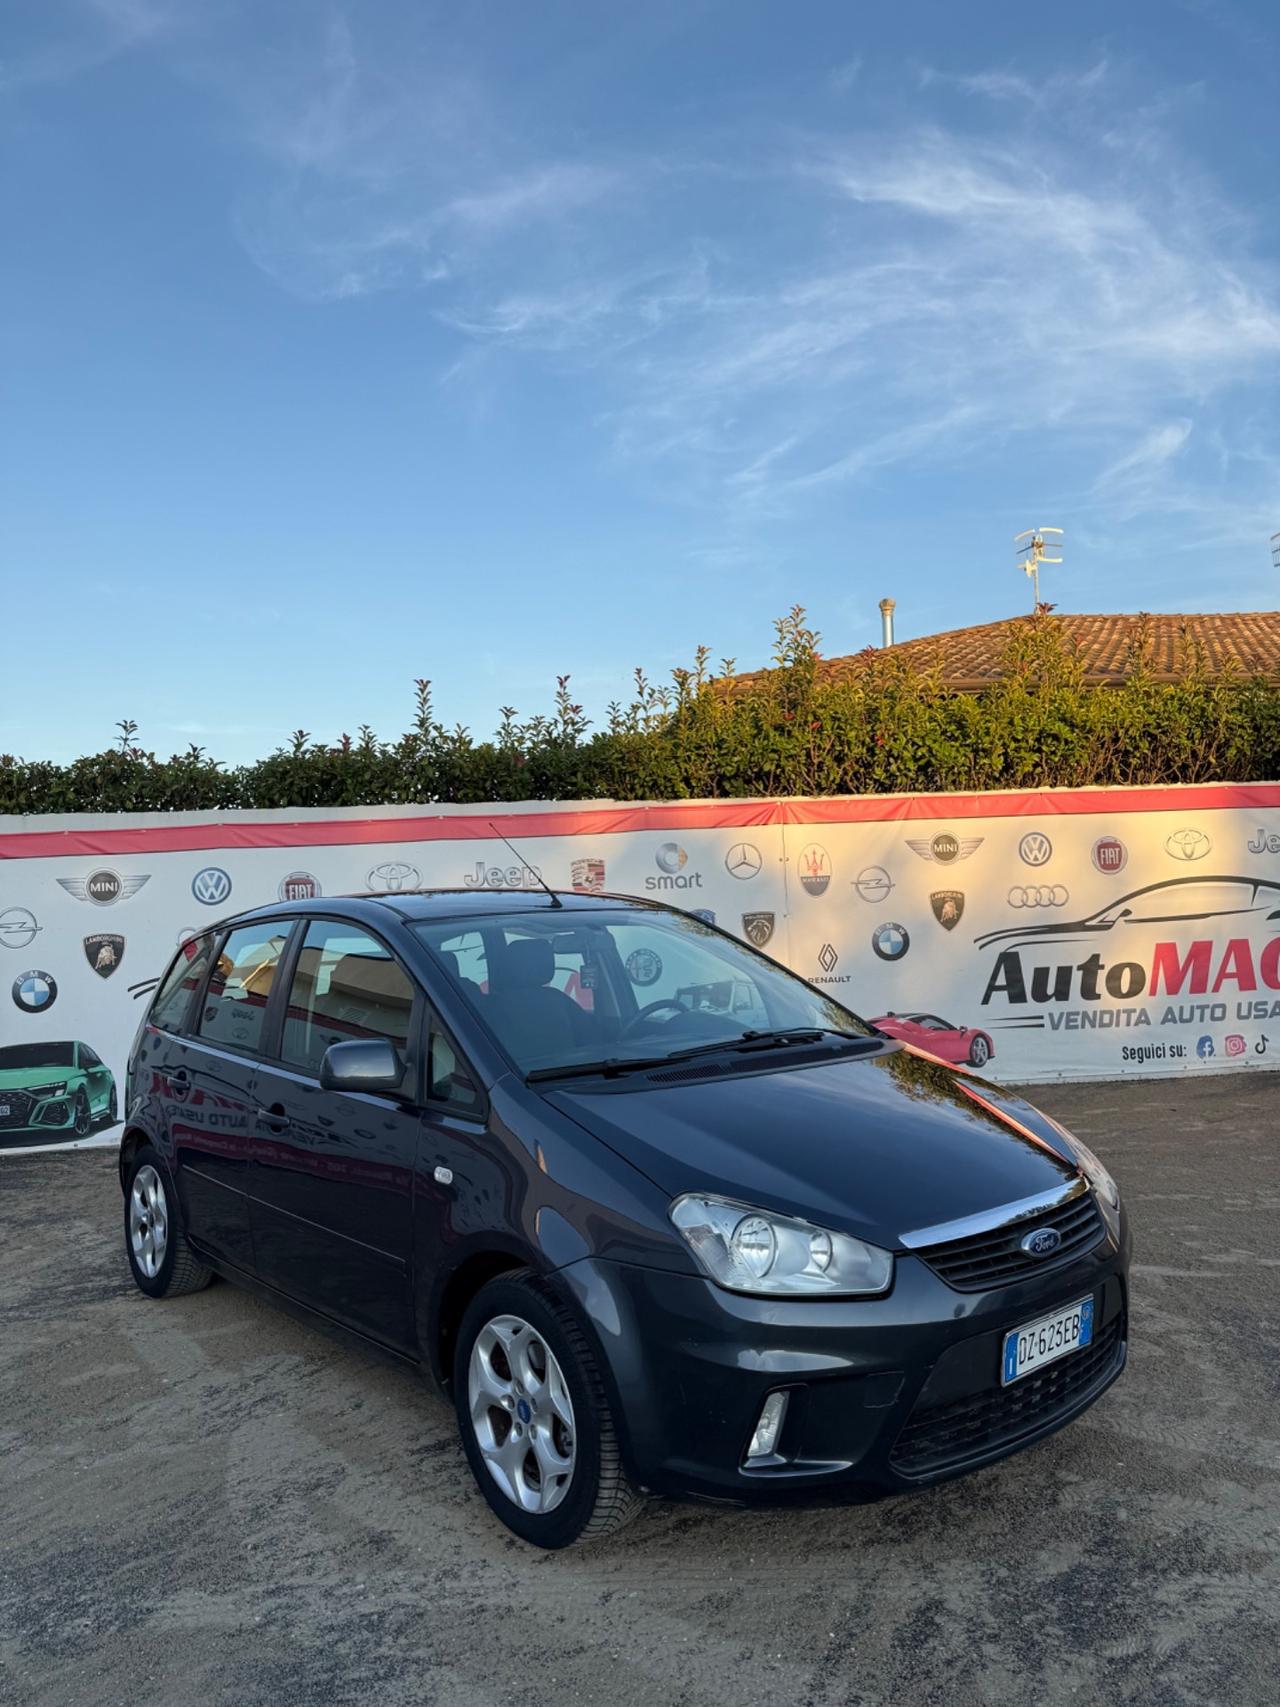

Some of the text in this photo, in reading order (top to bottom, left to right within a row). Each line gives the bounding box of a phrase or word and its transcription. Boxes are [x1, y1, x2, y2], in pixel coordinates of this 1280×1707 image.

[934, 843, 958, 853] MINI
[1100, 847, 1121, 865] FIAT
[464, 862, 542, 888] Jeep
[645, 872, 703, 890] smart
[90, 882, 118, 892] MINI
[289, 884, 313, 900] FIAT
[807, 975, 852, 984] RENAULT
[1048, 1007, 1151, 1030] VENDITA
[1160, 1003, 1227, 1025] AUTO
[1122, 1043, 1187, 1064] Seguici su:
[1036, 1234, 1055, 1251] Ford
[1019, 1314, 1080, 1364] DZ 623EB
